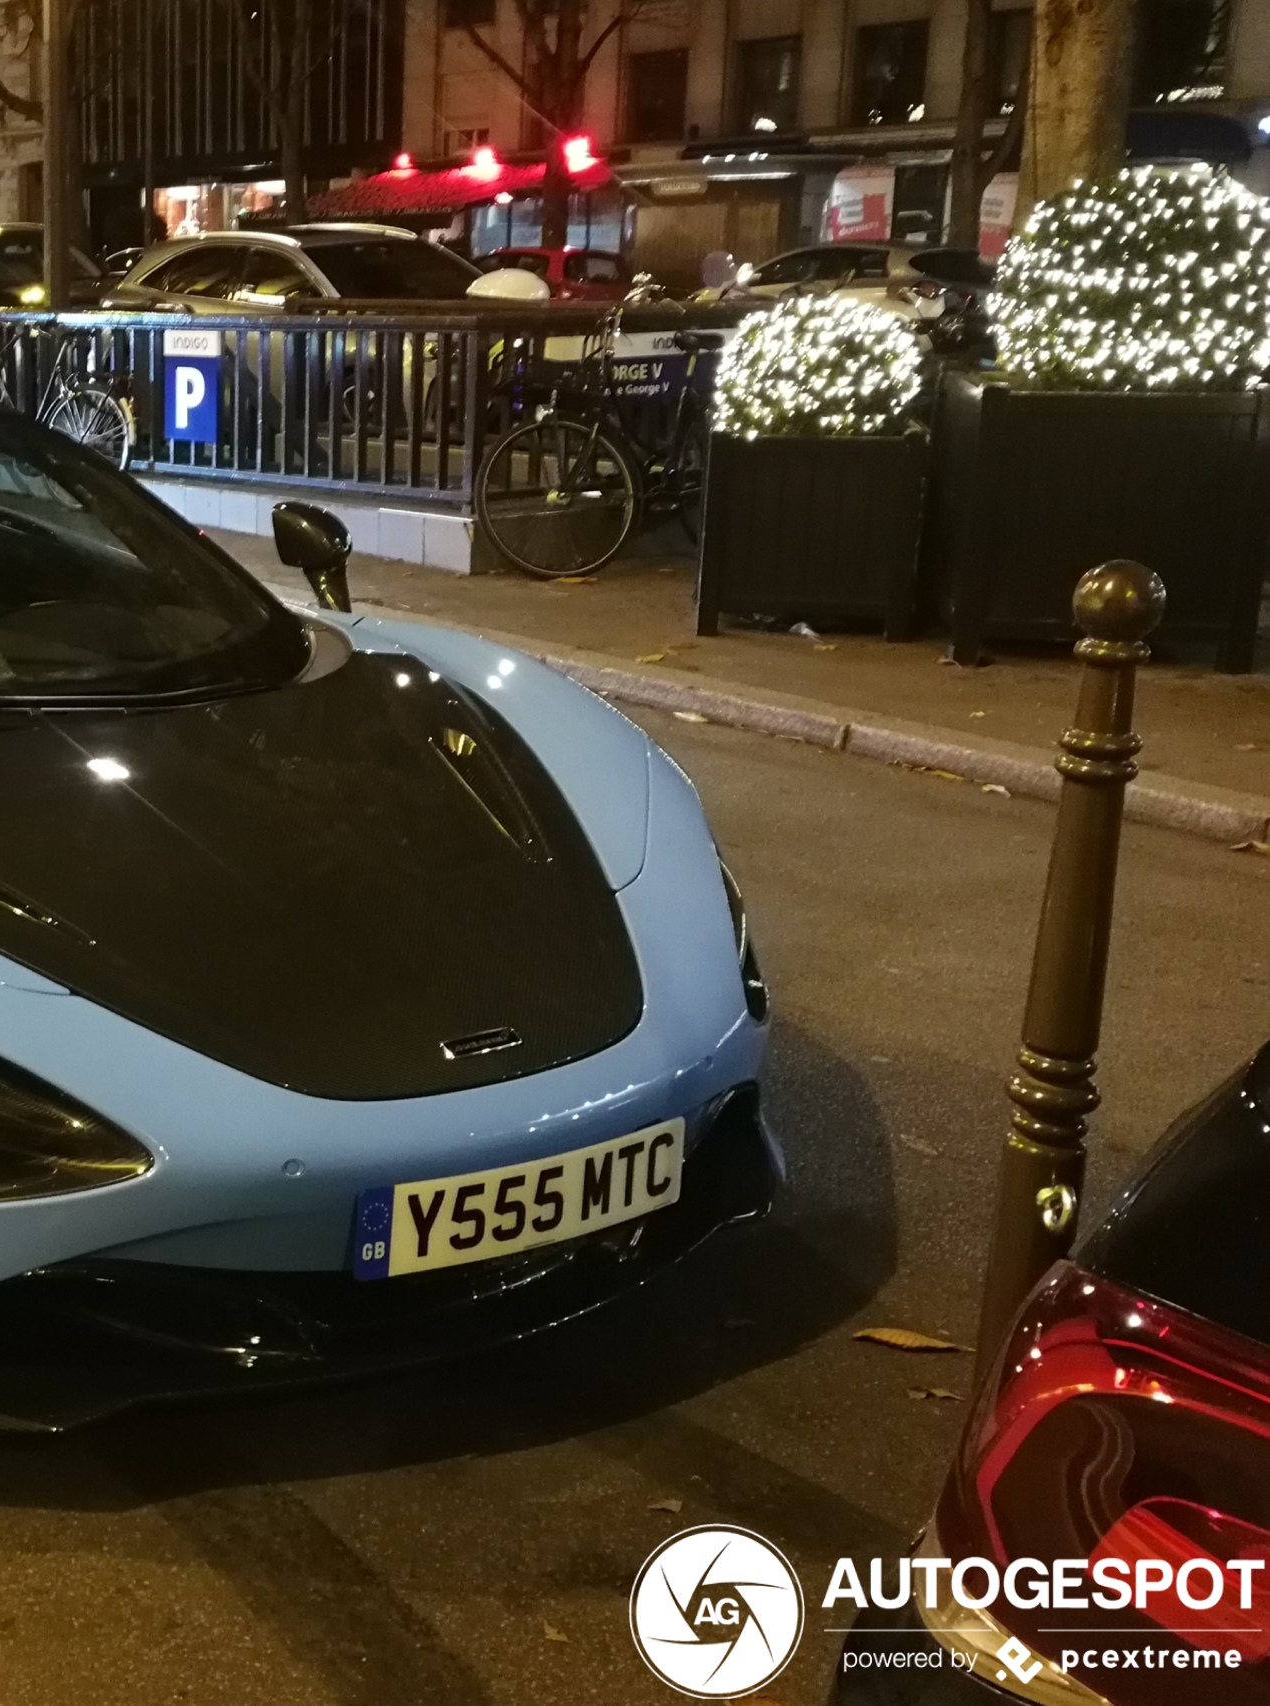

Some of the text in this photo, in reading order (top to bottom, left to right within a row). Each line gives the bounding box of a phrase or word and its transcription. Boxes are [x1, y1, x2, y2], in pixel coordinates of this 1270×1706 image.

[173, 337, 209, 351] INDIGO
[653, 336, 679, 350] IND
[613, 362, 664, 380] ORGE V
[175, 366, 205, 429] P
[625, 383, 661, 397] George
[662, 381, 670, 393] V
[407, 1132, 675, 1258] Y555 MTC
[362, 1241, 386, 1262] GB
